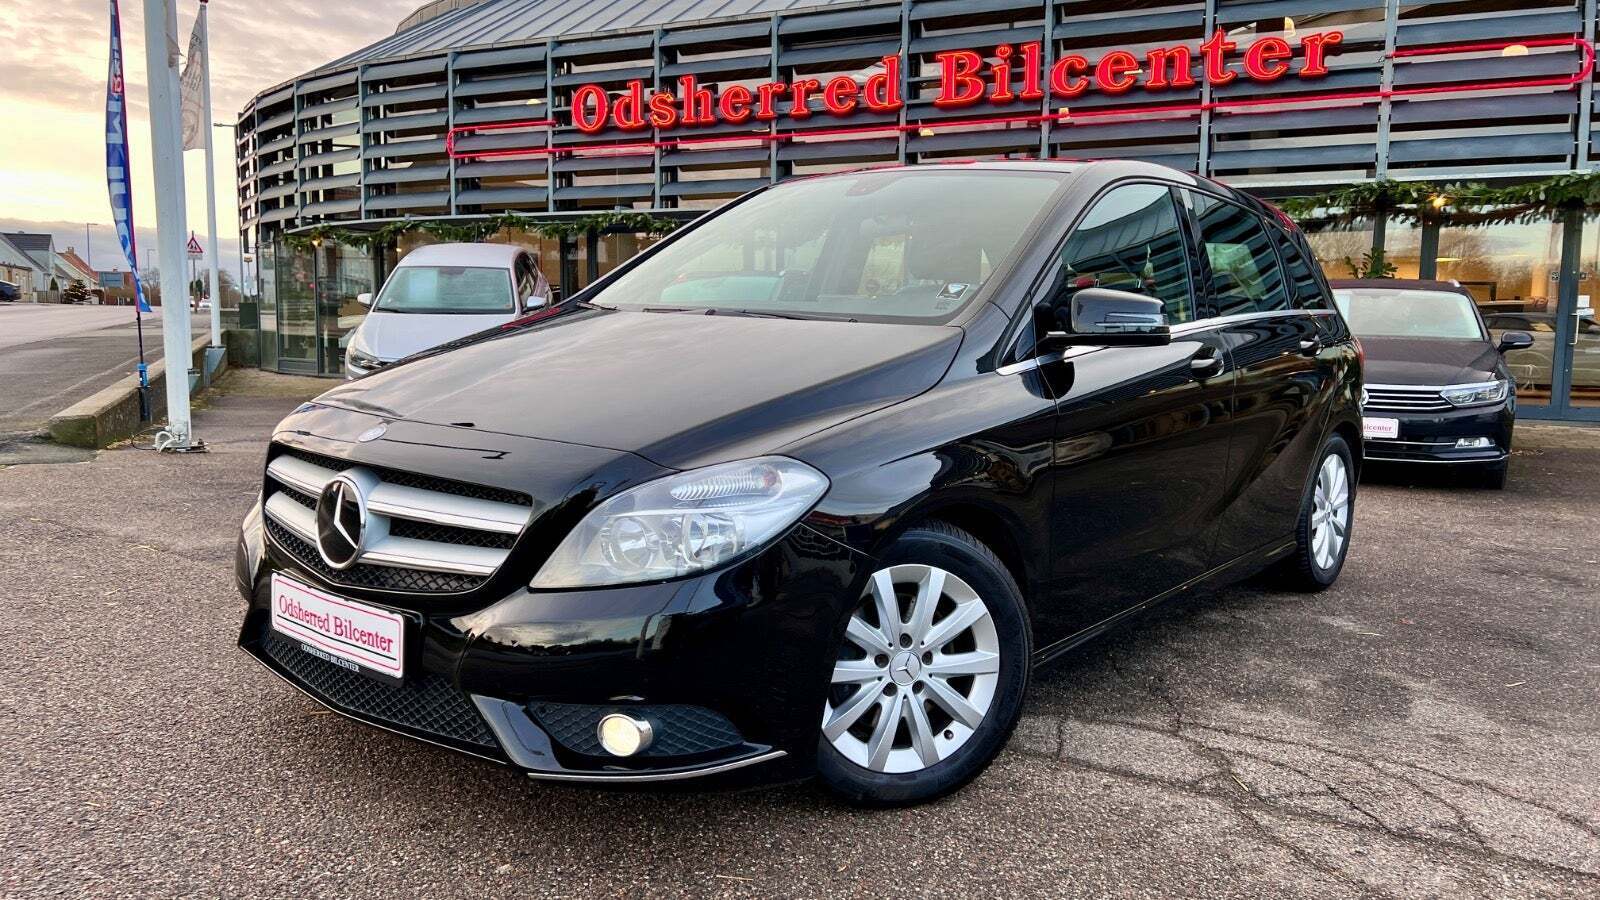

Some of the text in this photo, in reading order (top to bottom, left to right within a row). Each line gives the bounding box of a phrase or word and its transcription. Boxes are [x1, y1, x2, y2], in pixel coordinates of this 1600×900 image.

[571, 29, 1344, 134] Odsherred Bilcenter
[278, 595, 394, 653] Odsherred Bilcenter
[331, 655, 360, 672] BILCENTER
